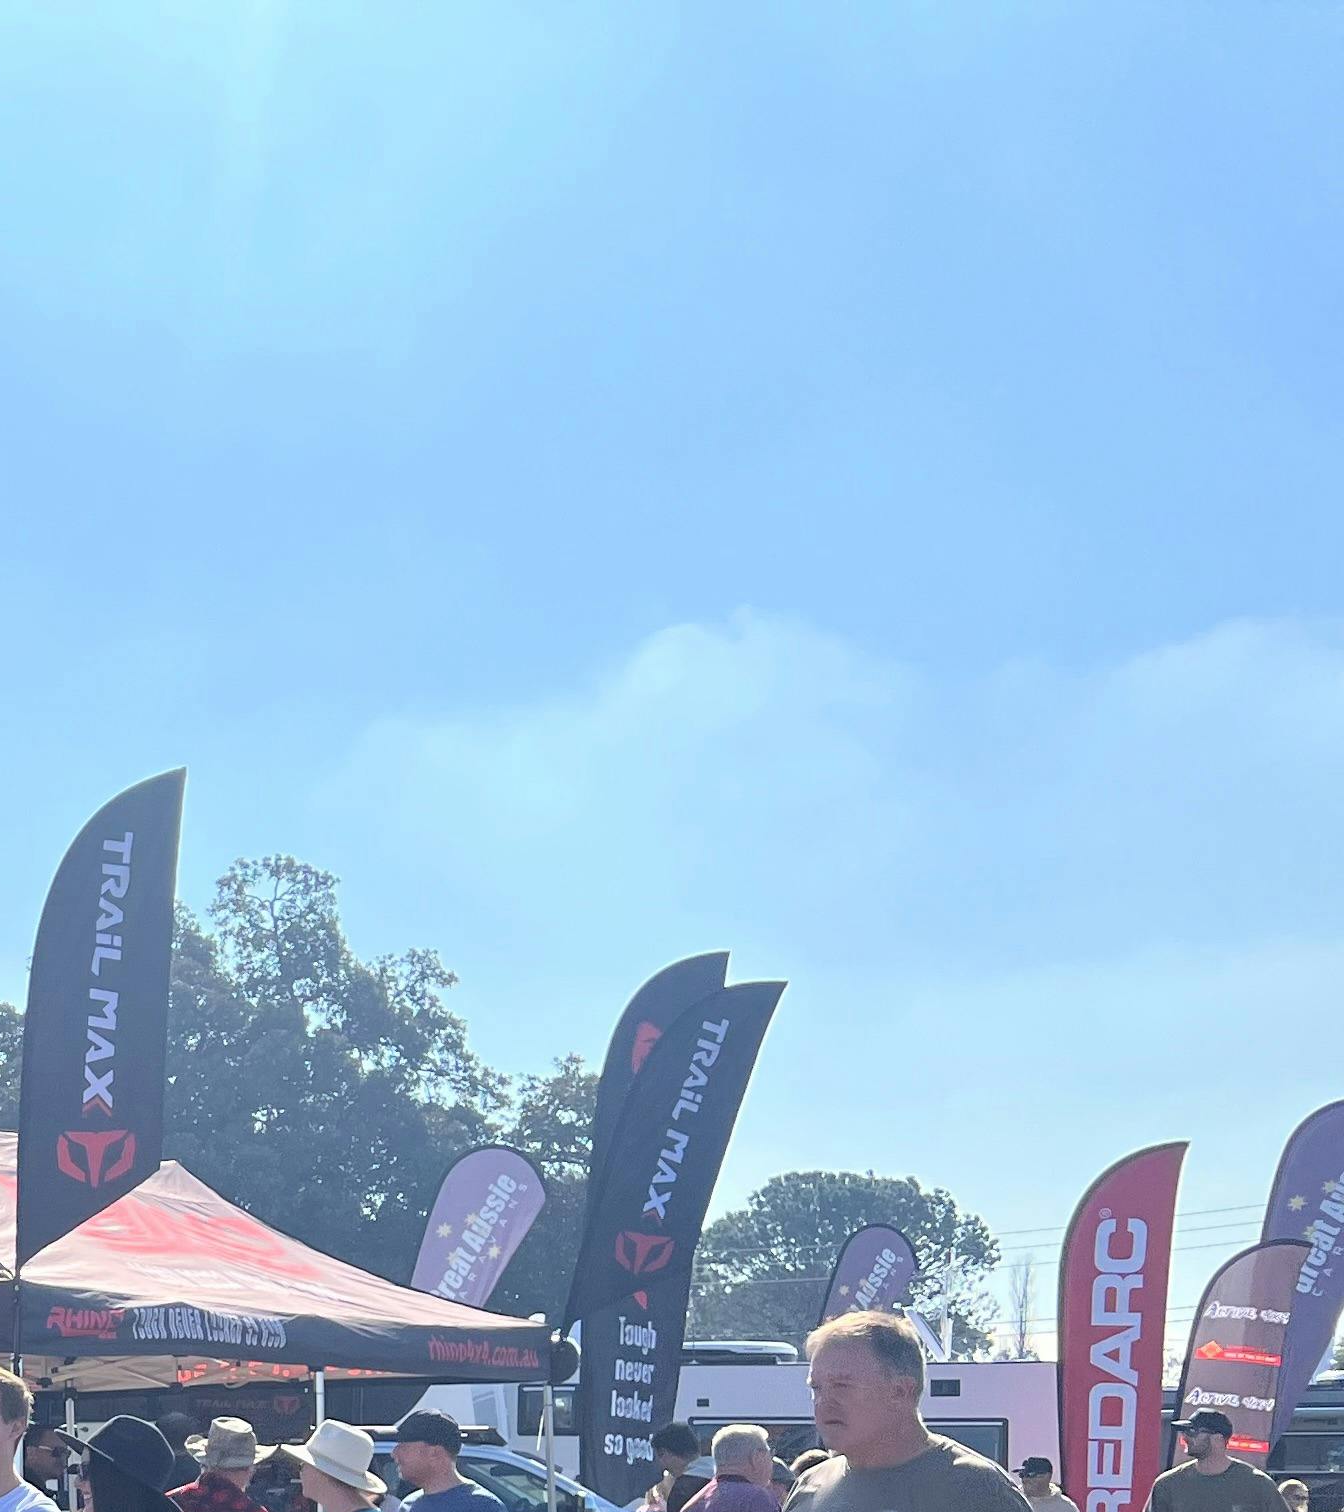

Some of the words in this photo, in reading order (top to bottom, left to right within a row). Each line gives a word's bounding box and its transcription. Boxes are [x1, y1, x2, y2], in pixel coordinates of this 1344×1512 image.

[83, 988, 119, 1108] MAX
[643, 1128, 690, 1220] MAX
[430, 1246, 478, 1300] reat
[461, 1174, 518, 1254] Aussie
[459, 1183, 529, 1300] ARAVANS
[618, 1316, 657, 1356] Tough
[614, 1358, 654, 1385] never
[610, 1389, 654, 1423] looked
[603, 1432, 624, 1456] so
